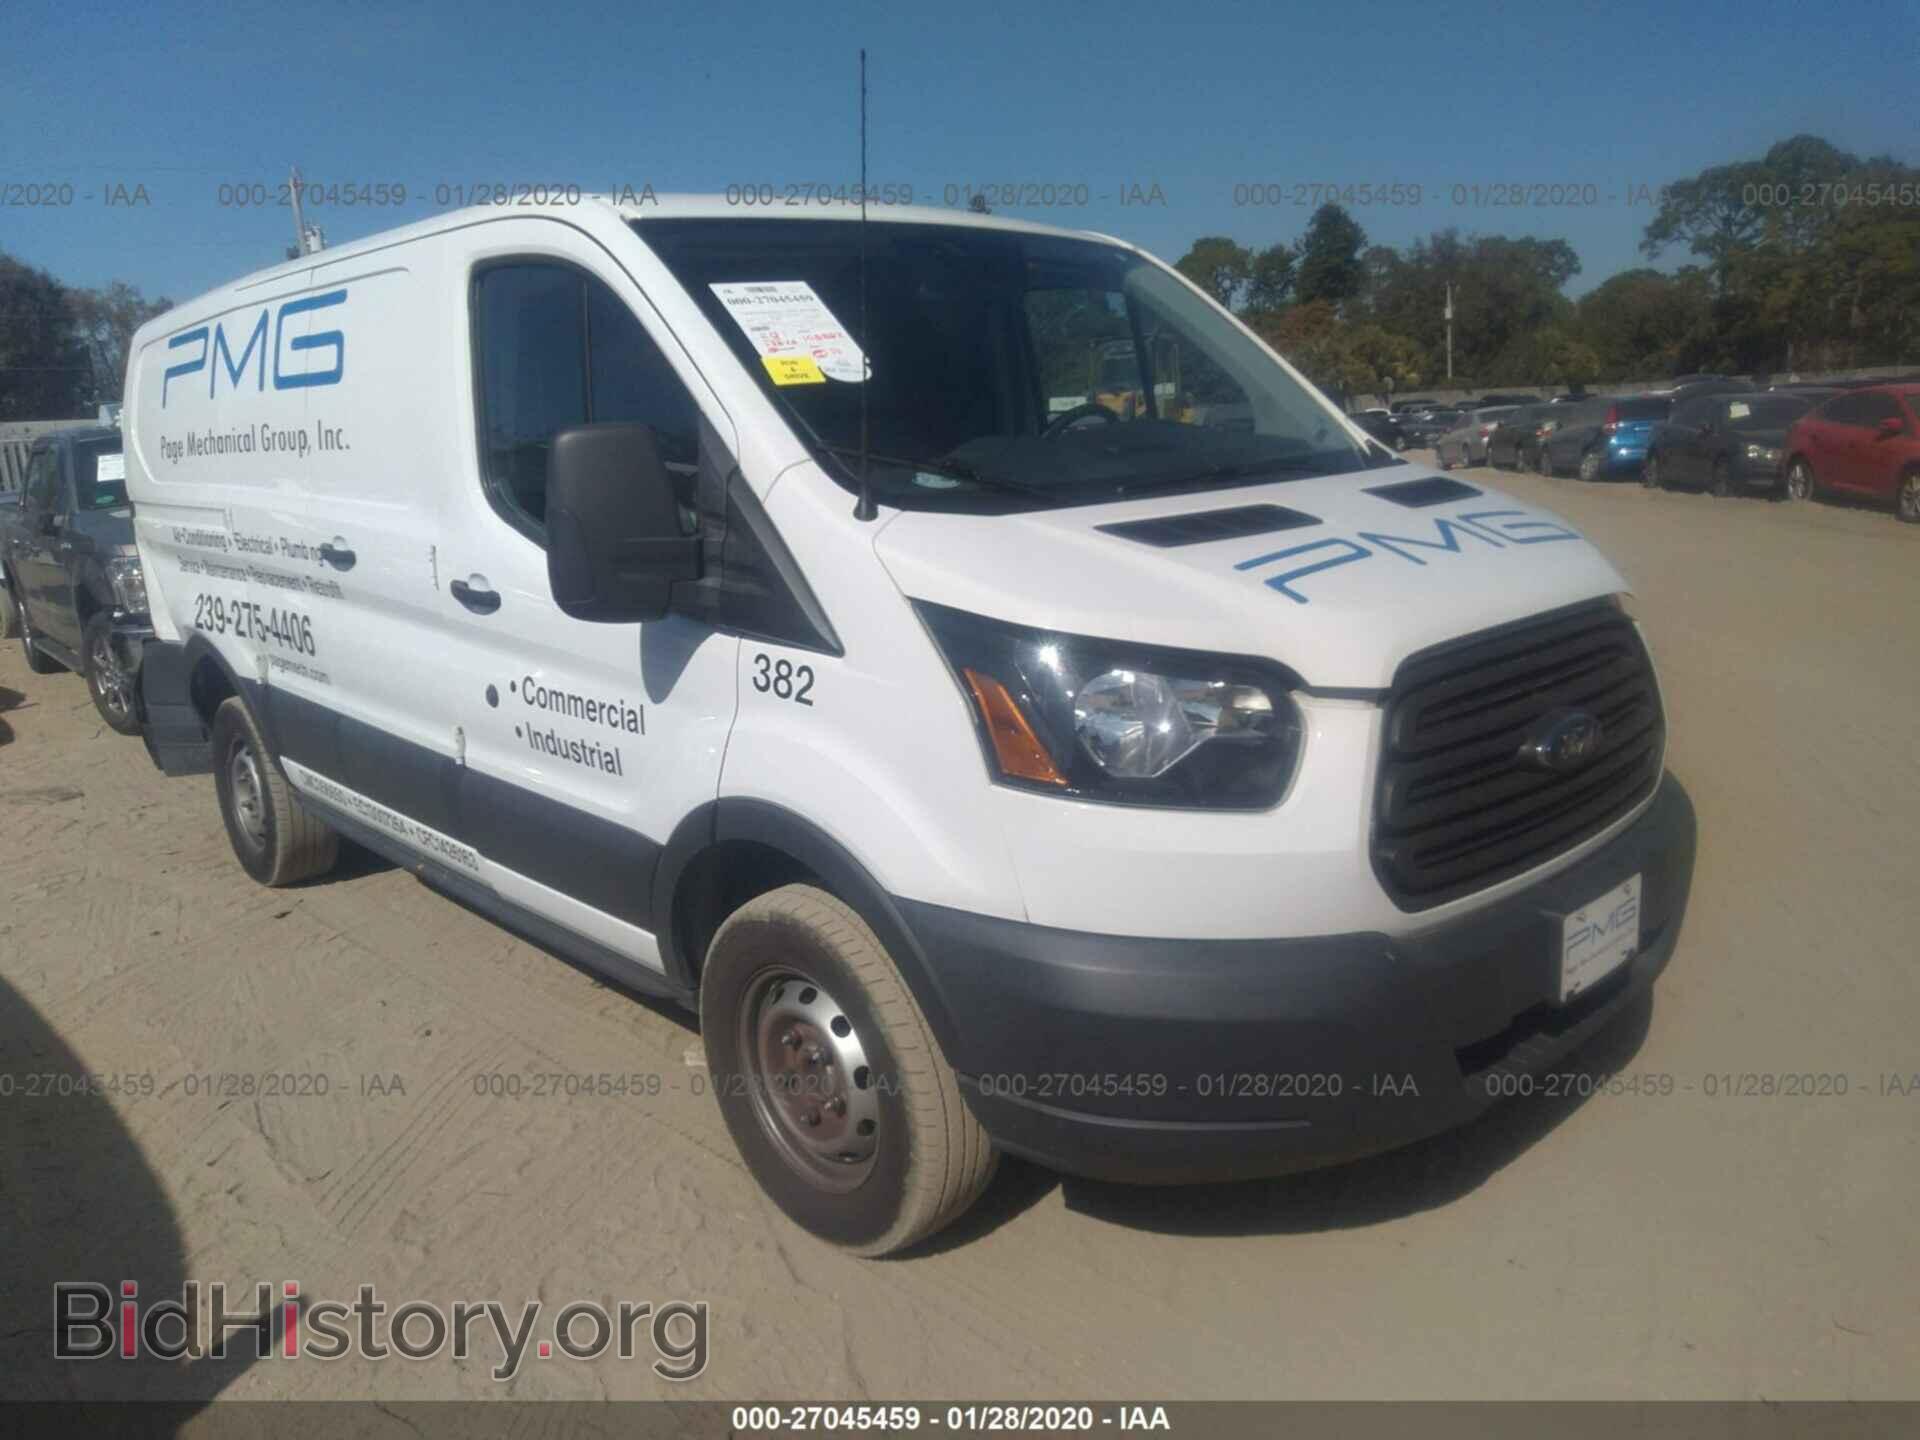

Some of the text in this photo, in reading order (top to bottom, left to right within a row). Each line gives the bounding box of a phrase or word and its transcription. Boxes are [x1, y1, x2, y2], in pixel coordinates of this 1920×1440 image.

[161, 288, 348, 408] PMG
[160, 419, 351, 464] Page Mechanical Group, Inc.
[1233, 510, 1585, 604] PMG
[194, 593, 316, 657] 239-275-4406
[521, 676, 647, 736] Commercial
[751, 653, 816, 707] 382
[526, 721, 624, 777] Industrial
